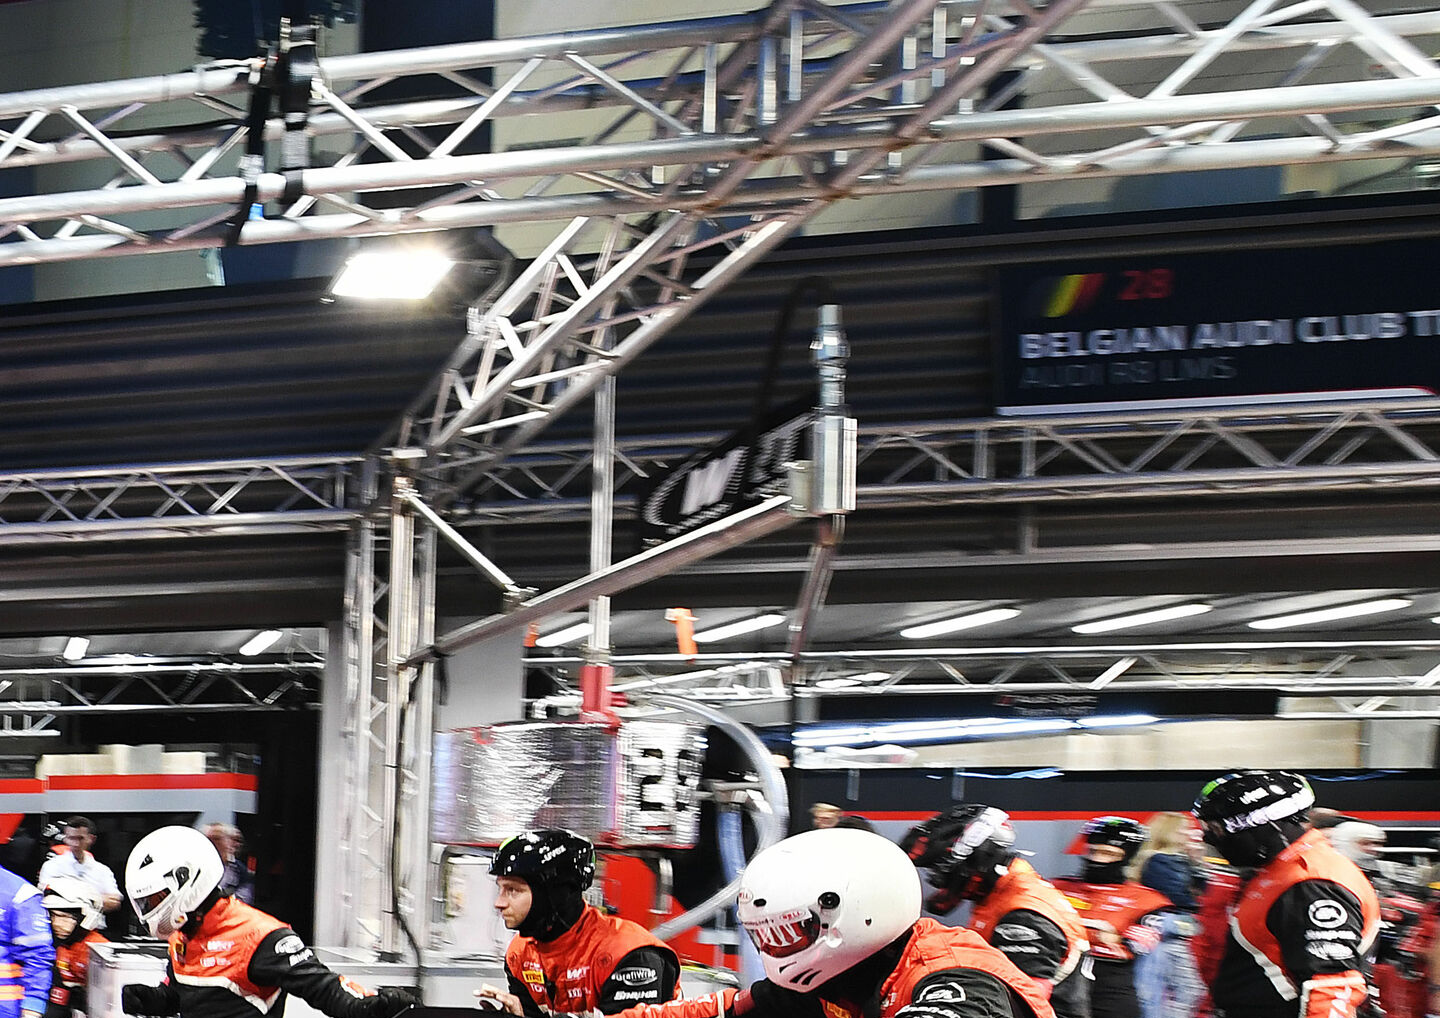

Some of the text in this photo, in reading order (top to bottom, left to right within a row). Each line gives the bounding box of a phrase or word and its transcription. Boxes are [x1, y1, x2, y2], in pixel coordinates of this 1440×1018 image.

[1120, 269, 1174, 300] 28
[1019, 324, 1189, 359] BELGIAN
[1191, 318, 1294, 350] AUDI
[1296, 311, 1408, 343] CLUB
[1020, 362, 1104, 388] AUDI
